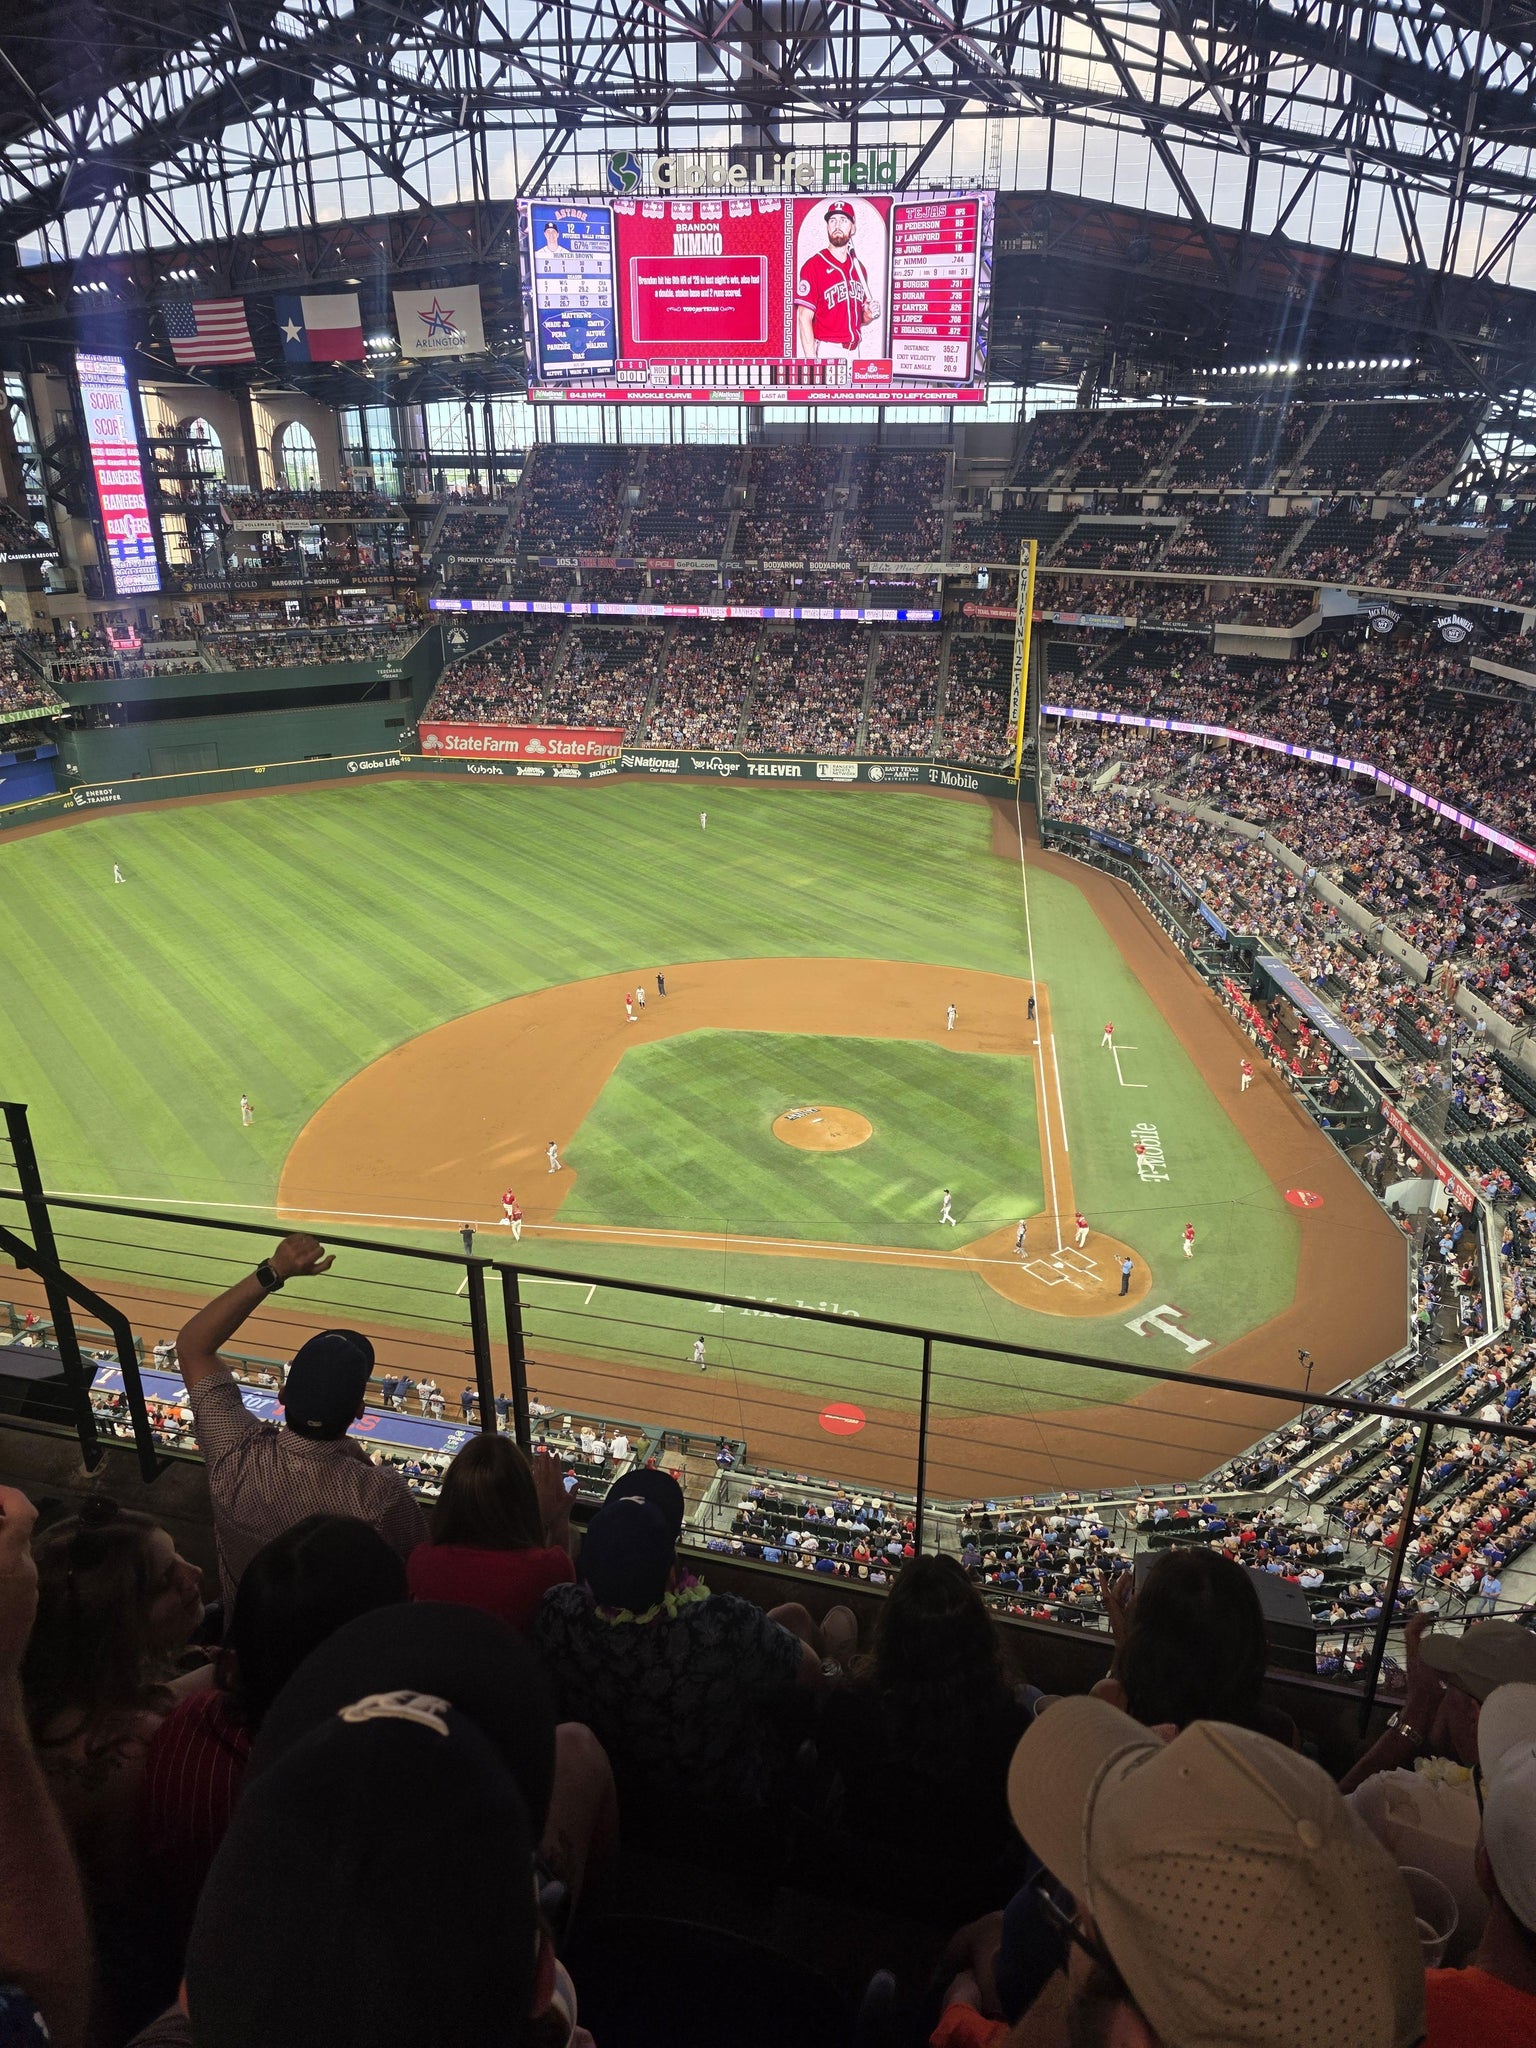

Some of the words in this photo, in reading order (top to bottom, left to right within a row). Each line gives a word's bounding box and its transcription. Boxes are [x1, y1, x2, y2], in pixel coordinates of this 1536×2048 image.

[652, 155, 748, 189] Globe
[755, 151, 815, 187] Life
[822, 150, 897, 186] Field
[555, 208, 588, 221] ASTROS
[906, 205, 946, 219] TEJAS
[675, 223, 720, 232] BRANDON
[904, 220, 940, 230] PEDERSON
[904, 232, 940, 242] LANGFORD
[673, 233, 723, 256] NIMMO
[904, 246, 922, 254] JUNG
[903, 257, 927, 265] NIMMO
[902, 280, 929, 289] BURGER
[901, 303, 928, 311] CARTER
[415, 336, 466, 348] ARLINGTON
[942, 345, 960, 353] 352.7
[653, 366, 667, 374] HOU
[943, 364, 957, 372] 20.9
[854, 372, 889, 380] Budweiser
[98, 469, 141, 486] RANGERS
[101, 493, 147, 511] RANGERS
[106, 514, 152, 539] RANGERS
[457, 556, 484, 564] PRIORITY
[556, 558, 579, 566] 105.3
[655, 560, 672, 568] PGL
[676, 561, 716, 569] GoPGL.com
[763, 561, 804, 569] BODYARMOR
[809, 561, 851, 569] BODYARMOR
[193, 581, 231, 590] PRIORITY
[234, 580, 258, 588] GOLD
[351, 576, 394, 584] PLUCKERS
[1016, 568, 1028, 638] CHIKIN
[1367, 608, 1381, 620] JACK
[1381, 605, 1402, 623] DANIEL'S
[1437, 615, 1452, 629] JACK
[1451, 614, 1474, 633] DANIEL'S
[1014, 643, 1023, 666] IZ
[1010, 673, 1021, 720] FARE
[8, 704, 60, 722] STAFFING
[359, 760, 384, 769] Globe
[384, 758, 400, 767] Life
[634, 756, 680, 769] National
[705, 756, 740, 777] Kroger
[467, 765, 504, 775] Kubota
[589, 768, 618, 778] HONDA
[940, 771, 979, 790] Mobile
[85, 788, 113, 797] ENERGY
[63, 800, 74, 808] 410
[86, 794, 121, 804] TRANSFER
[1389, 1112, 1403, 1132] SPEC'S
[1455, 1184, 1473, 1207] SPEC'S
[1124, 1304, 1216, 1355] T
